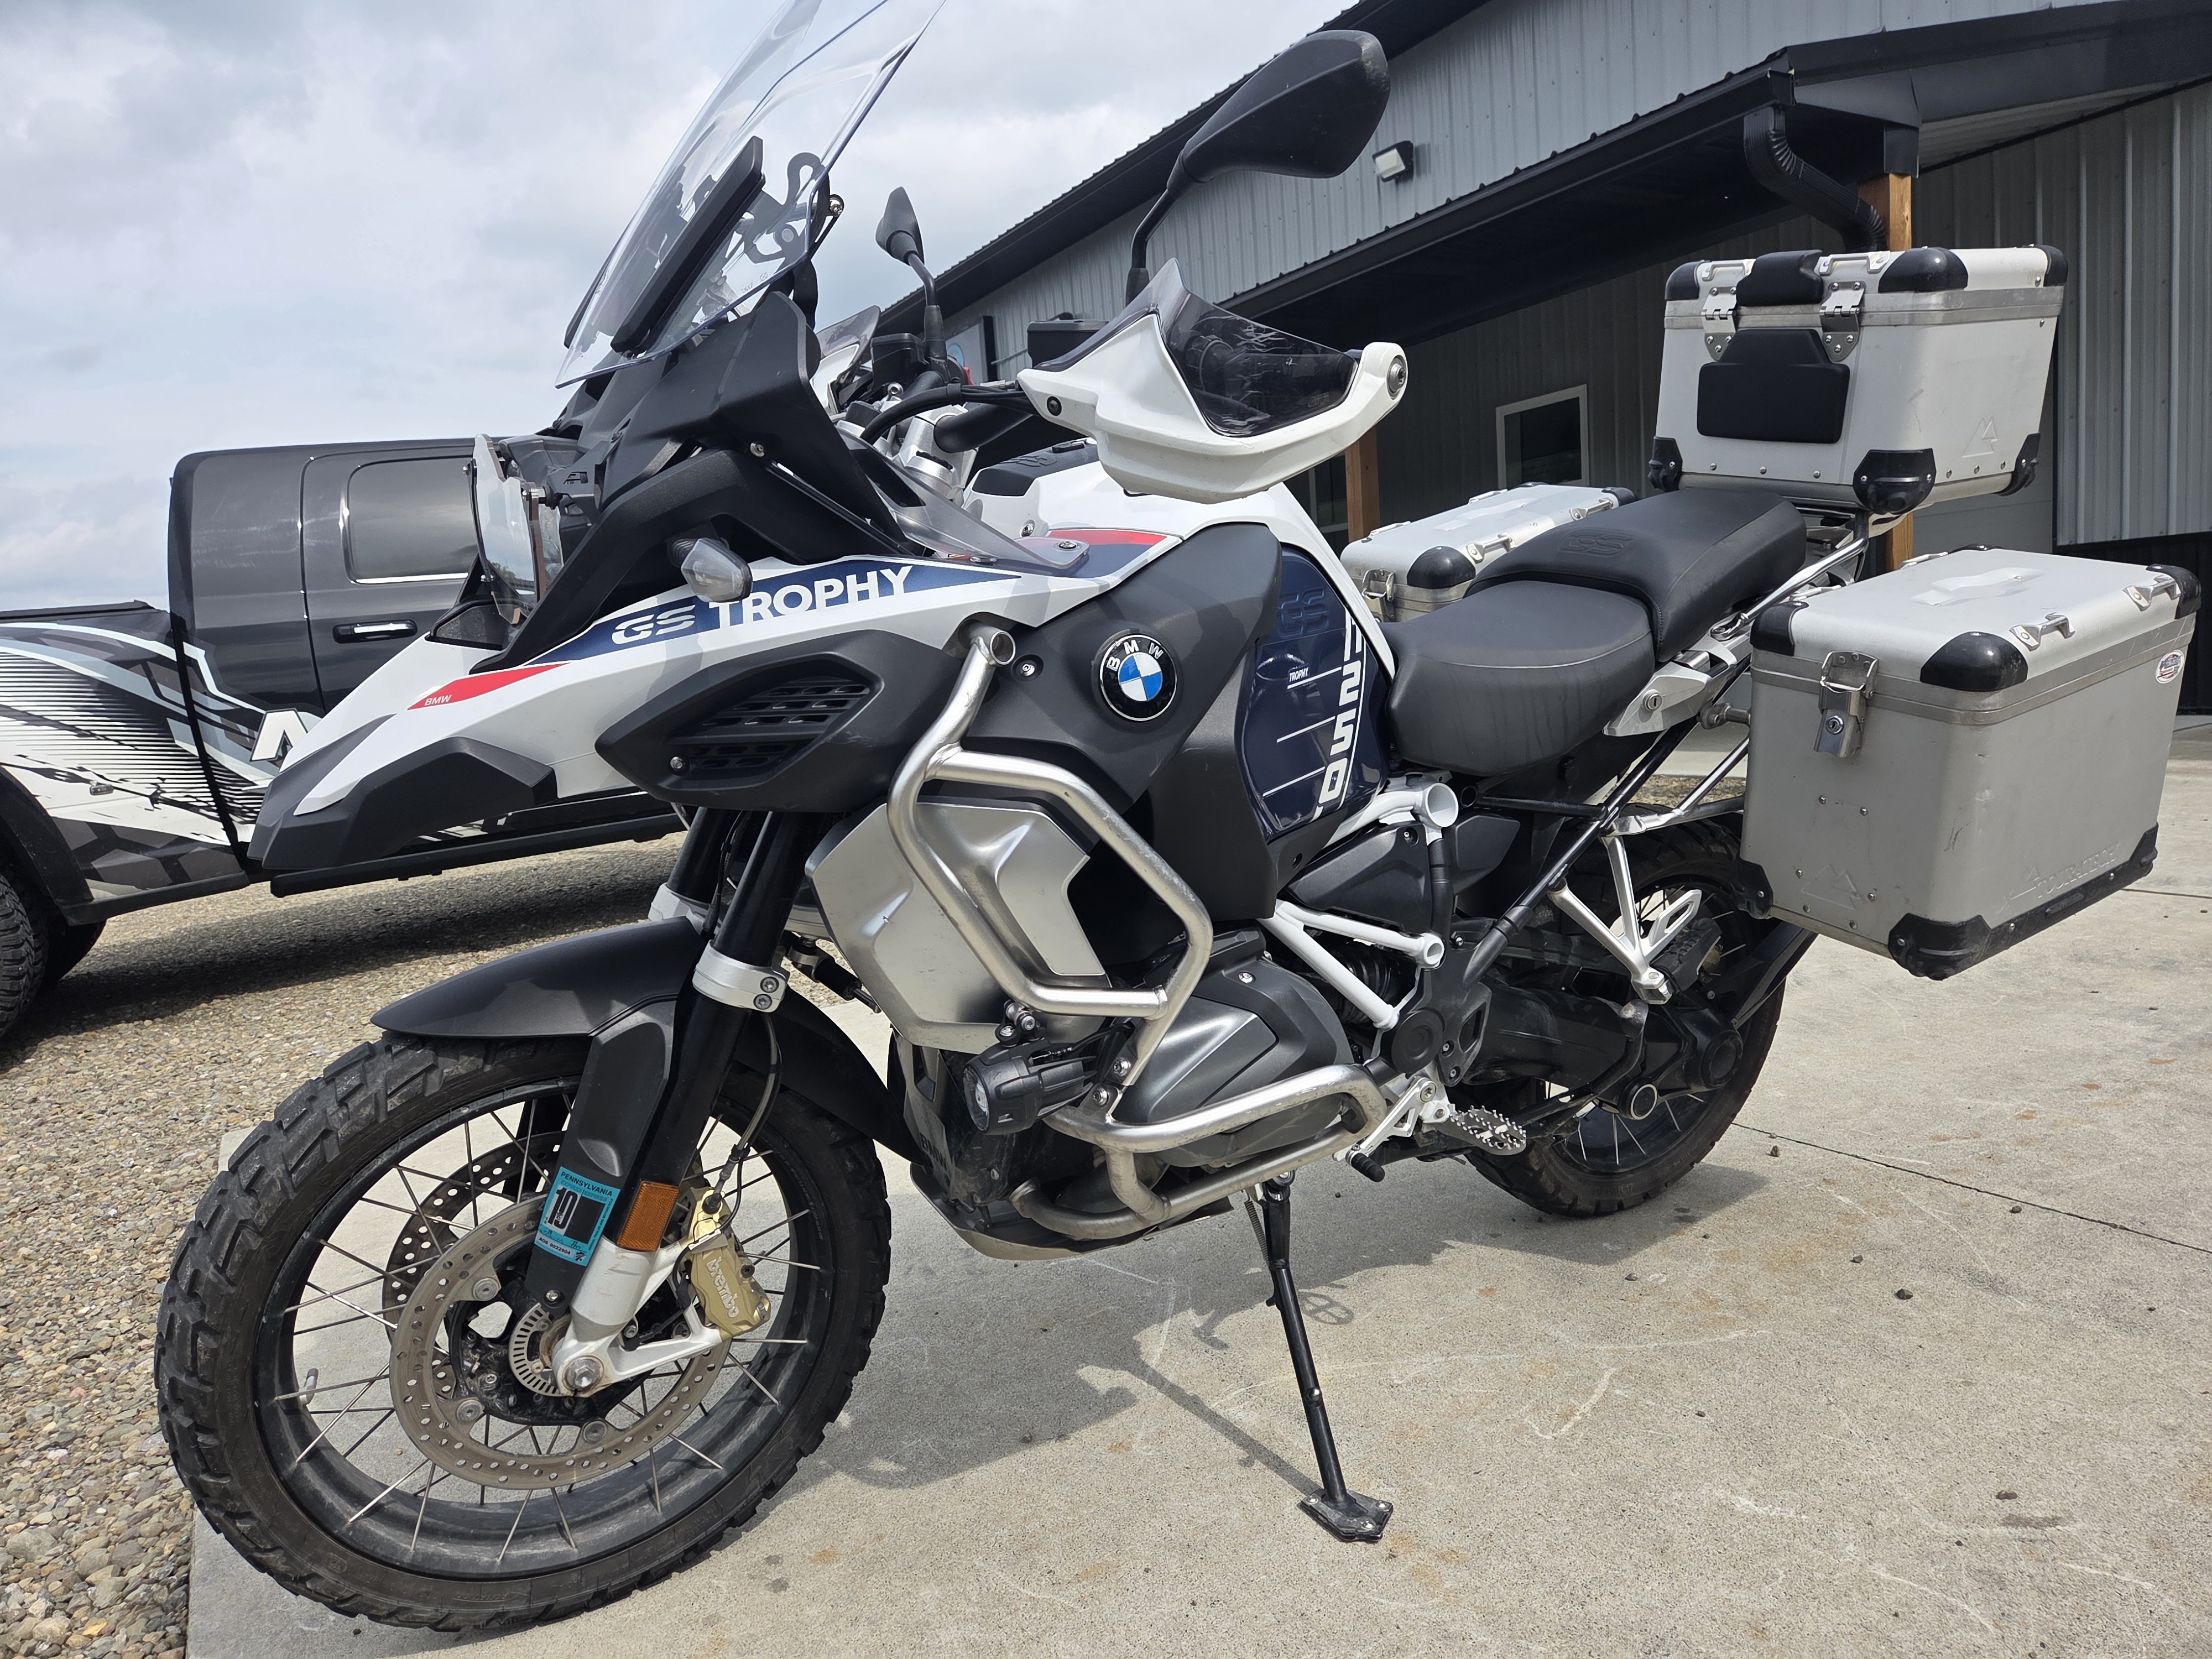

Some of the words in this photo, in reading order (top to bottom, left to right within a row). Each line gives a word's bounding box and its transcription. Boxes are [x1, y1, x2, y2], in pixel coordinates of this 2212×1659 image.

[612, 604, 696, 645] GS
[709, 565, 913, 630] TROPHY
[1276, 587, 1329, 638] GS
[1106, 639, 1164, 671] BMW
[1289, 667, 1309, 682] TROPHY
[424, 695, 452, 706] BMW
[919, 1132, 947, 1172] BMW
[560, 1171, 612, 1197] PENNSYLVANIA
[547, 1187, 578, 1229] 10
[706, 1256, 739, 1318] brembo
